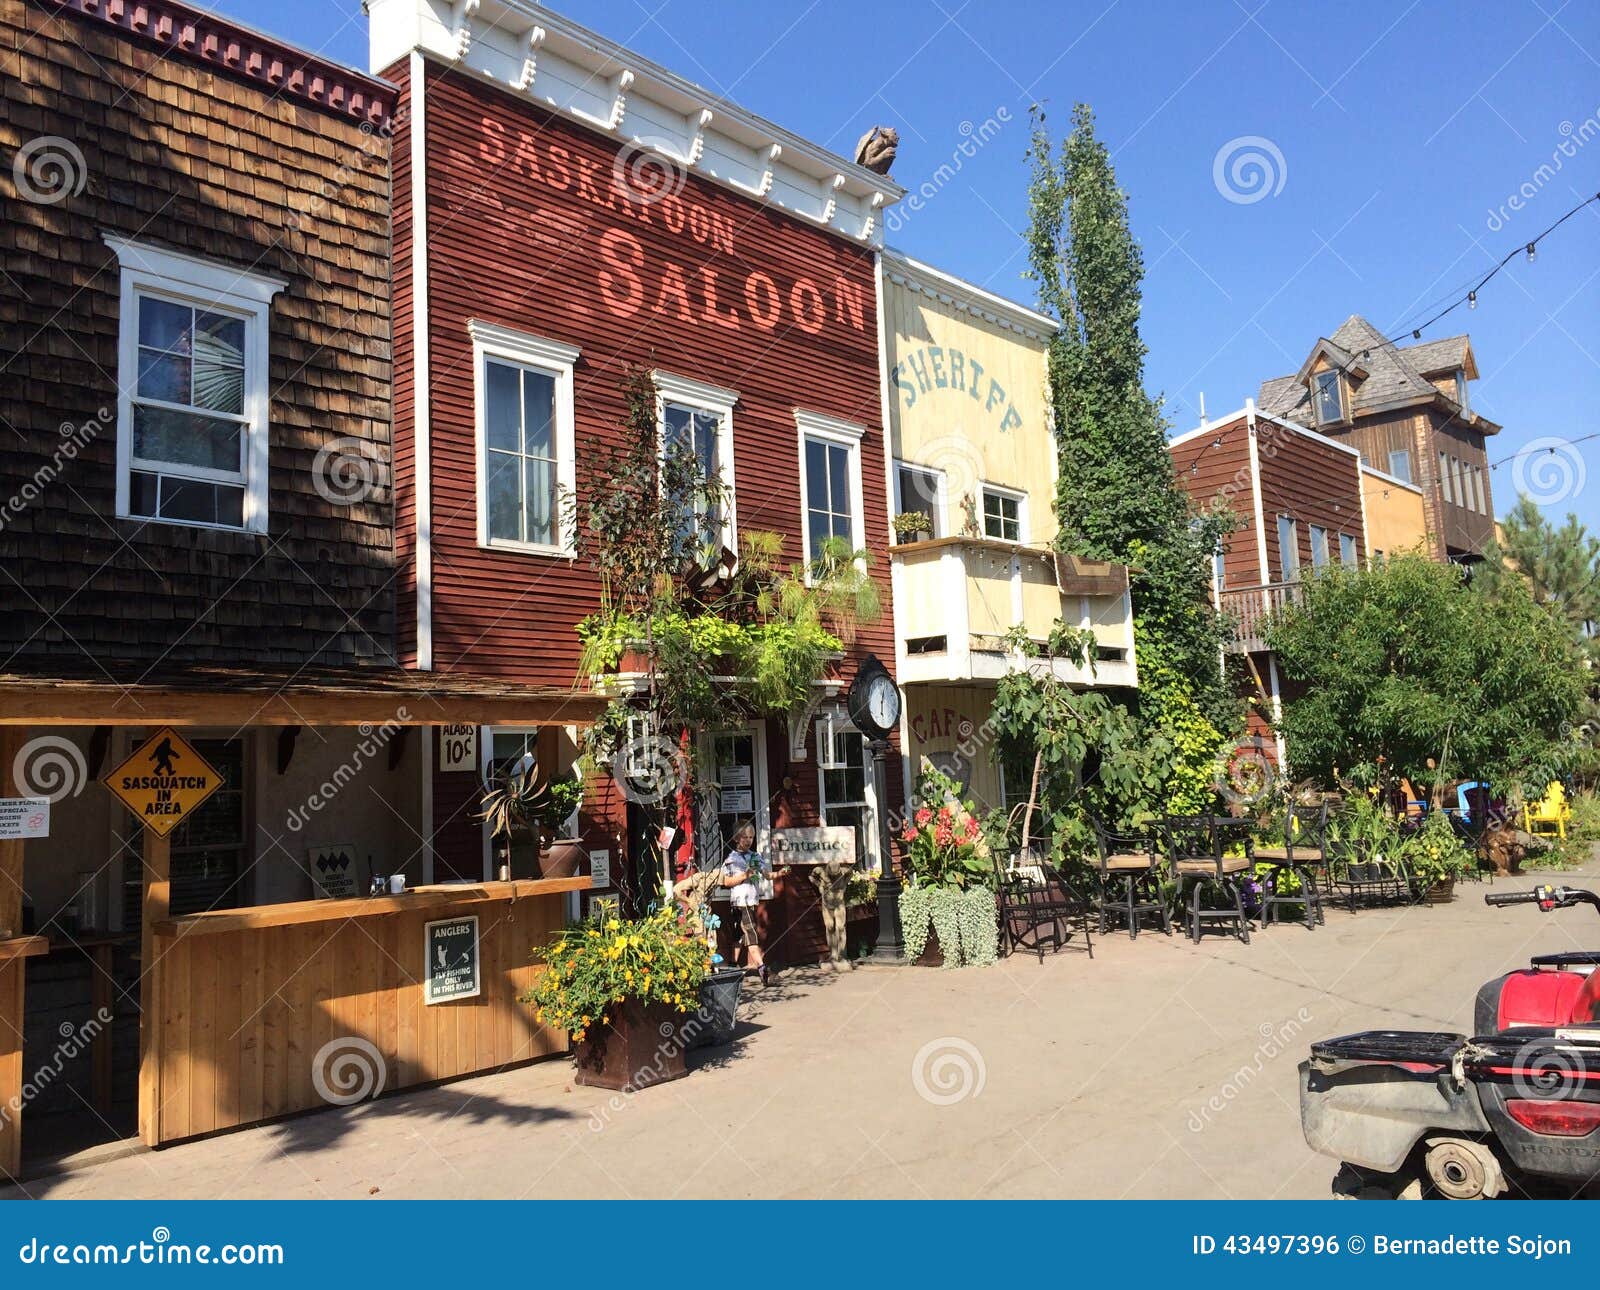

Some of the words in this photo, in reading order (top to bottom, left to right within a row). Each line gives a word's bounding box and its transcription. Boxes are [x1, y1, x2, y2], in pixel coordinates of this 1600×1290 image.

[479, 117, 736, 256] SASKATOON
[598, 227, 865, 334] SALOON
[892, 345, 1022, 434] SHERIFF
[122, 776, 206, 790] SASQUATCH
[156, 789, 171, 802] IN
[144, 802, 182, 815] AREA
[434, 924, 470, 938] ANGLERS
[435, 971, 447, 980] FLY
[447, 967, 471, 978] FISHING
[444, 976, 462, 985] ONLY
[433, 986, 441, 995] IN
[442, 984, 455, 993] THIS
[455, 981, 474, 991] RIVER
